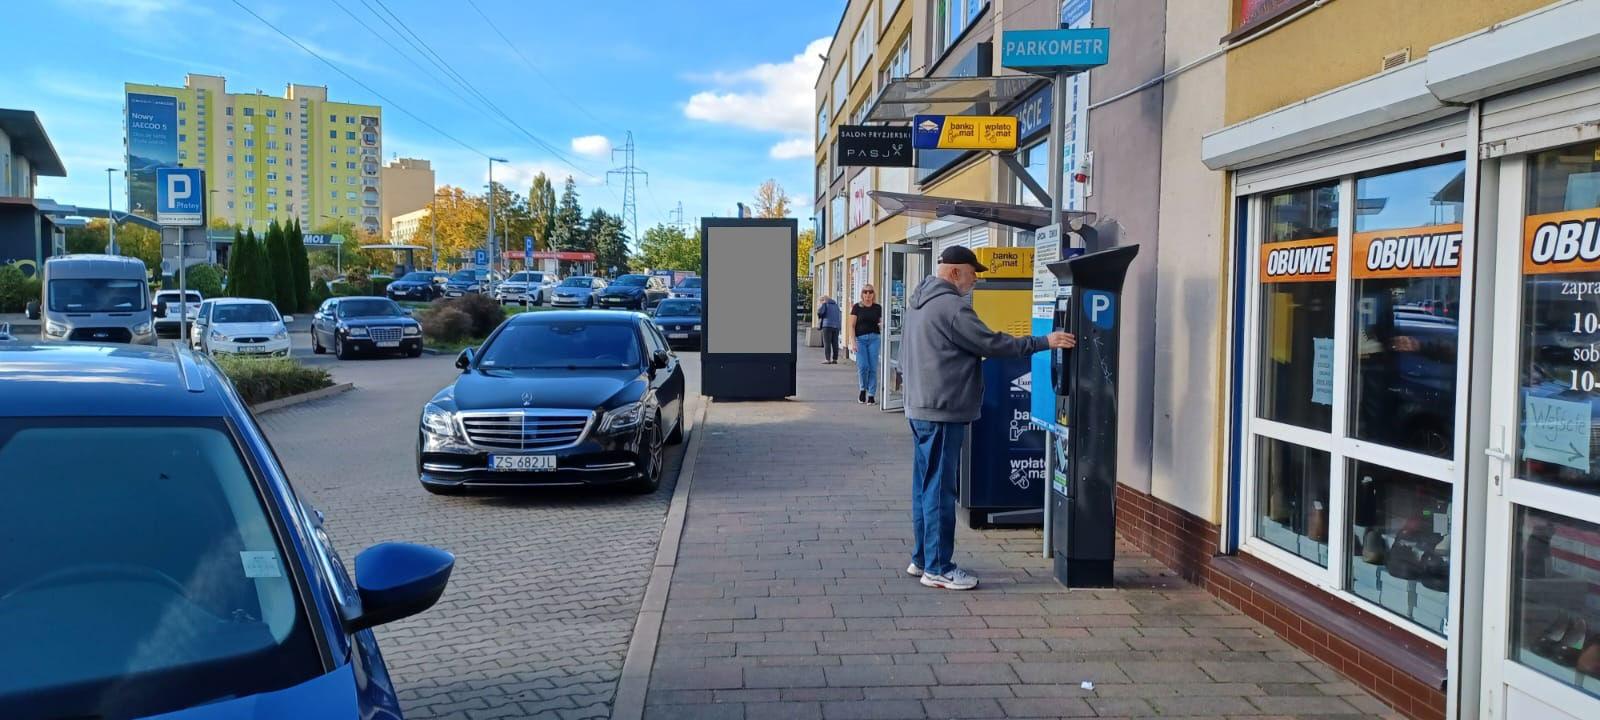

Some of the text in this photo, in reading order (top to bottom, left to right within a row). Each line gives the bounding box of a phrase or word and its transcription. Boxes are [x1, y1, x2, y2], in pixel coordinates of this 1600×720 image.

[1006, 38, 1104, 56] PARKOMETR
[131, 112, 154, 121] Nowy
[132, 122, 161, 130] JAECOO
[950, 122, 974, 130] banko
[868, 131, 911, 139] FRYZJERSKI
[959, 129, 974, 137] mat
[996, 129, 1011, 137] mat
[167, 174, 192, 209] P
[303, 234, 324, 244] MOL
[526, 239, 531, 251] P
[1532, 221, 1600, 264] OBU
[478, 251, 485, 264] P
[992, 252, 1018, 260] banko
[1367, 234, 1462, 270] OBUWIE
[1267, 245, 1334, 275] OBUWIE
[1091, 294, 1111, 322] P
[495, 456, 555, 468] ZS 682JL
